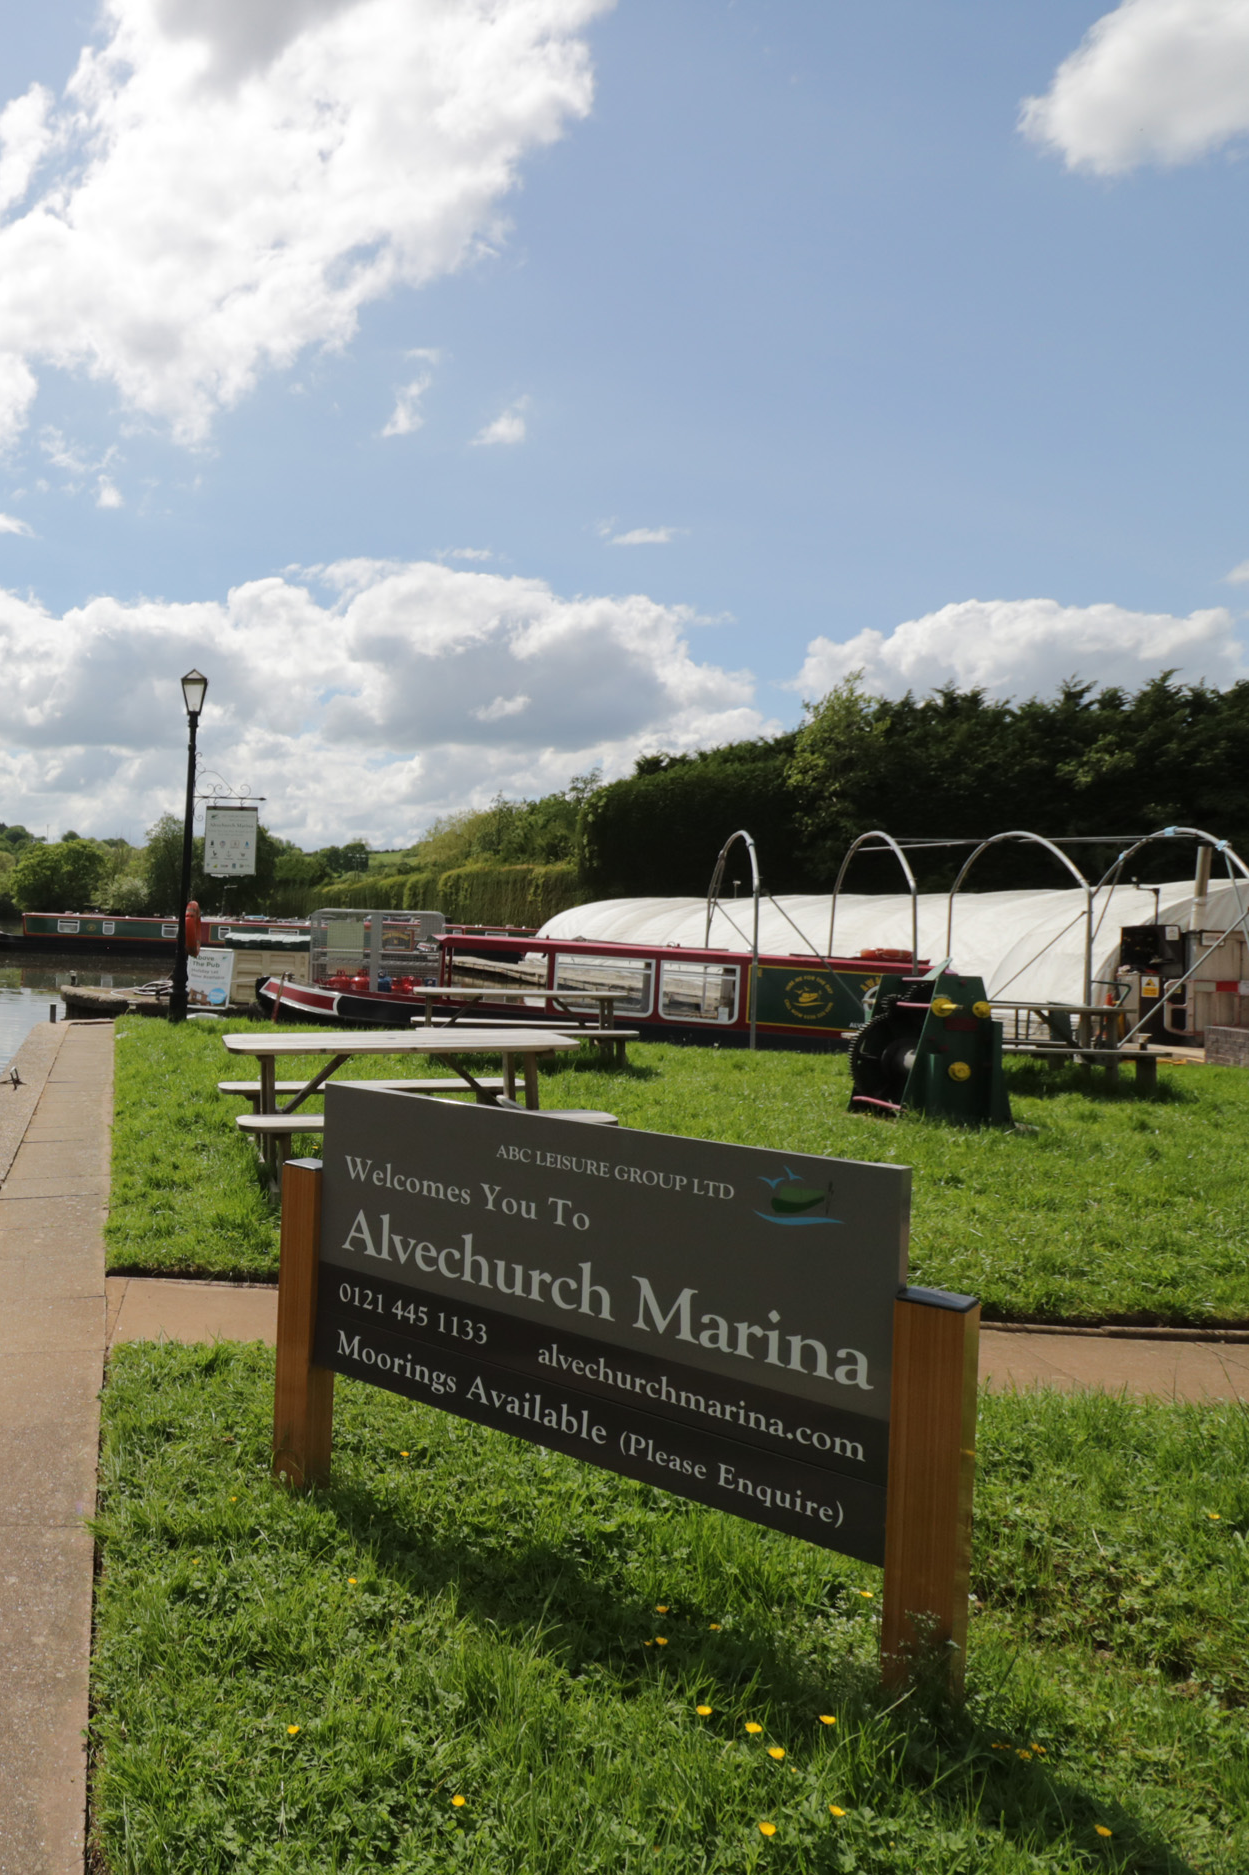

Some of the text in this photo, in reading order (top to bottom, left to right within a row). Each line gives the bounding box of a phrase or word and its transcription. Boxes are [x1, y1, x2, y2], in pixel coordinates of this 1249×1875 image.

[344, 1155, 590, 1231] Welcomes You To
[496, 1144, 735, 1200] ABC LEISURE GROUP LTD
[339, 1282, 488, 1345] 0121 445 1133
[341, 1208, 875, 1391] Alvechurch Marina
[336, 1329, 844, 1529] Moorings Available (Please Enquire)
[537, 1343, 866, 1462] alvechurchmarina.com
